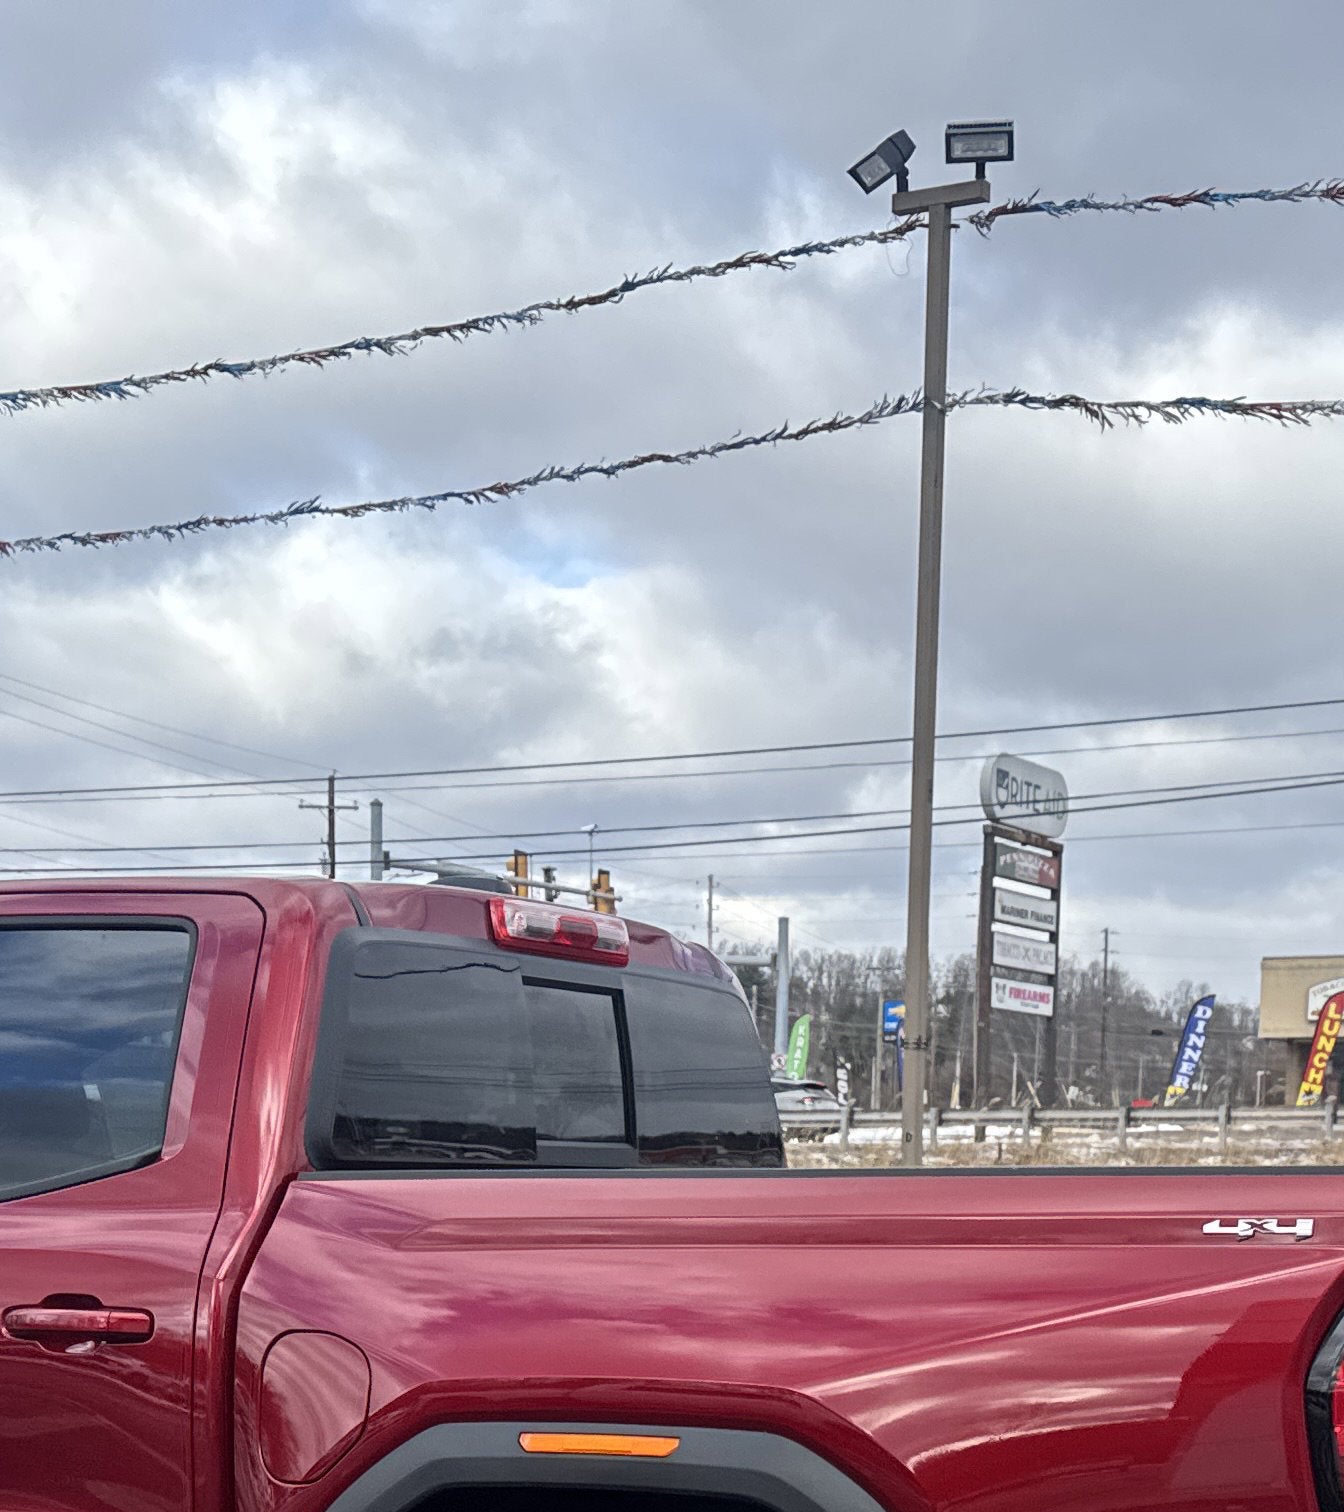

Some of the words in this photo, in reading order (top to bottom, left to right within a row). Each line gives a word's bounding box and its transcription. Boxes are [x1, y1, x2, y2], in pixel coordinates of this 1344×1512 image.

[1010, 776, 1041, 814] RITE
[1043, 788, 1066, 820] AID
[1000, 904, 1029, 920] MARINER
[1030, 910, 1054, 925] FINANCE
[1009, 986, 1051, 1005] FIREARMS
[1173, 1004, 1213, 1088] DINNER
[1308, 1001, 1342, 1085] LUNCH
